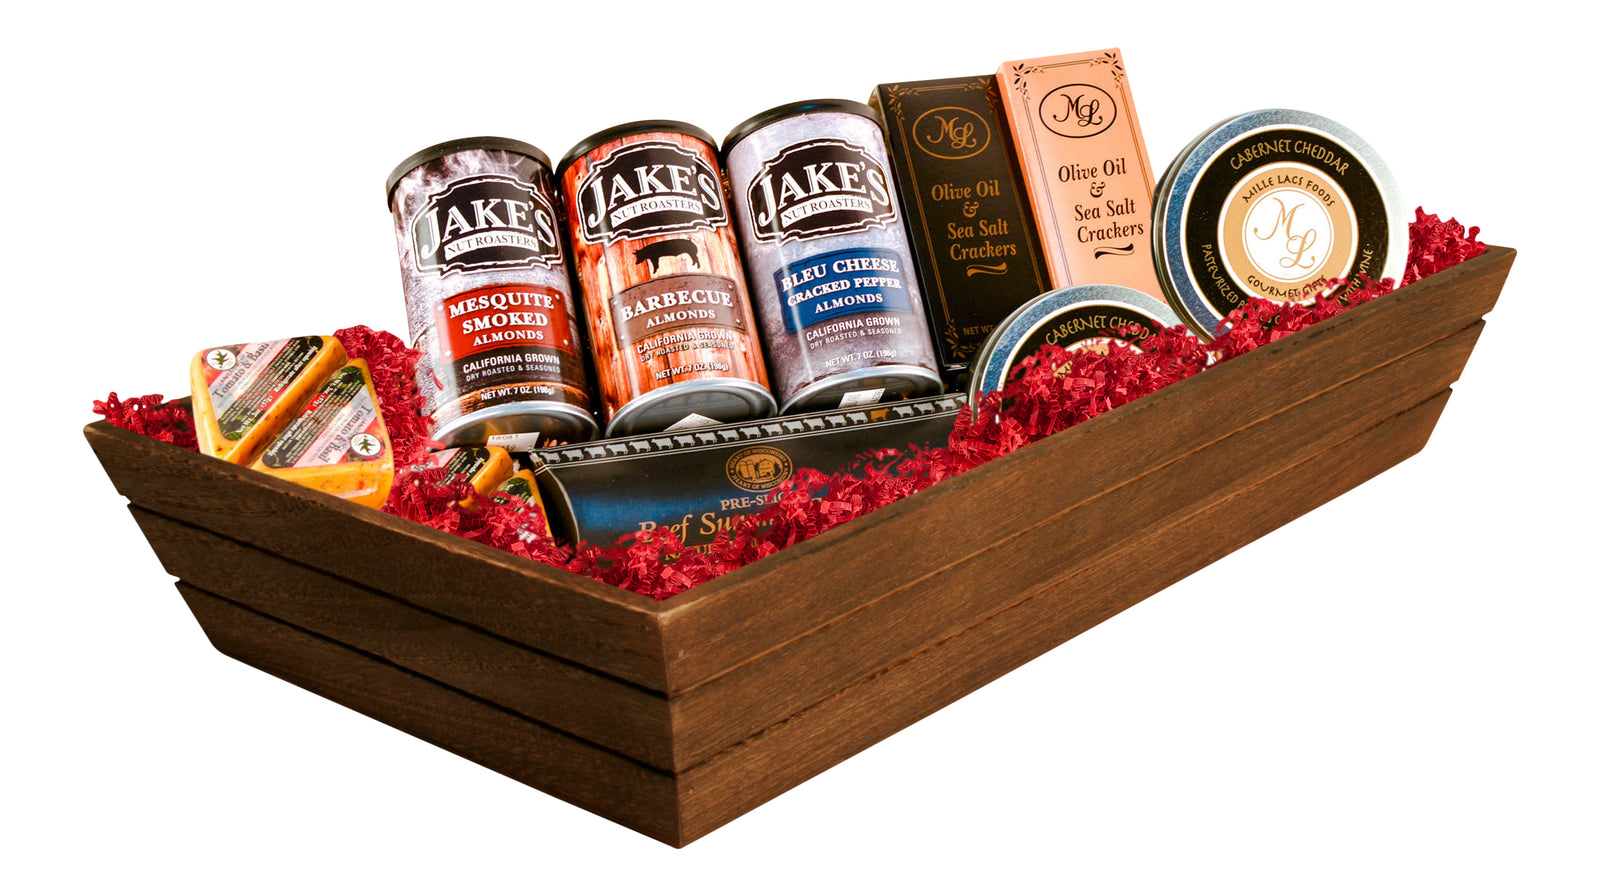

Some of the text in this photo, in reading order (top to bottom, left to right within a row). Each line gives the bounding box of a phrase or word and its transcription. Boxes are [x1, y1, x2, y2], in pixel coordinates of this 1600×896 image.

[1230, 139, 1350, 176] CABERNET CHEDDAR
[1058, 158, 1127, 183] Olive Oil
[587, 164, 720, 229] JAKE'S
[758, 161, 889, 227] JAKE'S
[931, 179, 1000, 201] Olive Oil
[1090, 182, 1105, 198] &
[1242, 175, 1336, 207] MILLE LACS FOODS
[613, 199, 702, 221] NUT ROASTERS
[783, 198, 871, 220] NUT ROASTERS
[963, 201, 979, 218] &
[1075, 198, 1136, 222] Sea Salt
[421, 198, 556, 260] JAKE'S
[947, 218, 1009, 240] Sea Salt
[1078, 221, 1144, 243] Crackers
[448, 234, 537, 255] NUT ROASTERS
[950, 241, 1017, 261] Crackers
[781, 257, 900, 292] BLEU CHEESE
[787, 277, 902, 307] CRACKED PEPPER
[1247, 275, 1299, 298] GOURMET
[449, 292, 554, 318] MESQUITE
[620, 289, 733, 322] BARBECUE
[815, 293, 883, 314] ALMONDS
[462, 312, 548, 335] SMOKED
[646, 309, 716, 328] ALMONDS
[806, 317, 901, 341] CALIFORNIA GROWN
[473, 329, 544, 347] ALMONDS
[810, 339, 823, 350] DRY
[825, 331, 858, 344] ROASTED
[867, 328, 902, 336] SEASONED
[962, 326, 978, 335] NET
[1045, 315, 1107, 345] CABERNET
[636, 331, 733, 354] CALIFORNIA GROWN
[640, 351, 654, 362] DRY
[656, 344, 689, 357] ROASTED
[462, 353, 560, 374] CALIFORNIA GROWN
[466, 372, 480, 382] DRY
[482, 364, 515, 377] ROASTED
[526, 364, 561, 374] SEASONED
[825, 359, 841, 368] NET
[213, 367, 244, 399] Tomato
[656, 370, 671, 380] NET
[481, 391, 496, 401] NET
[497, 388, 512, 398] WT.
